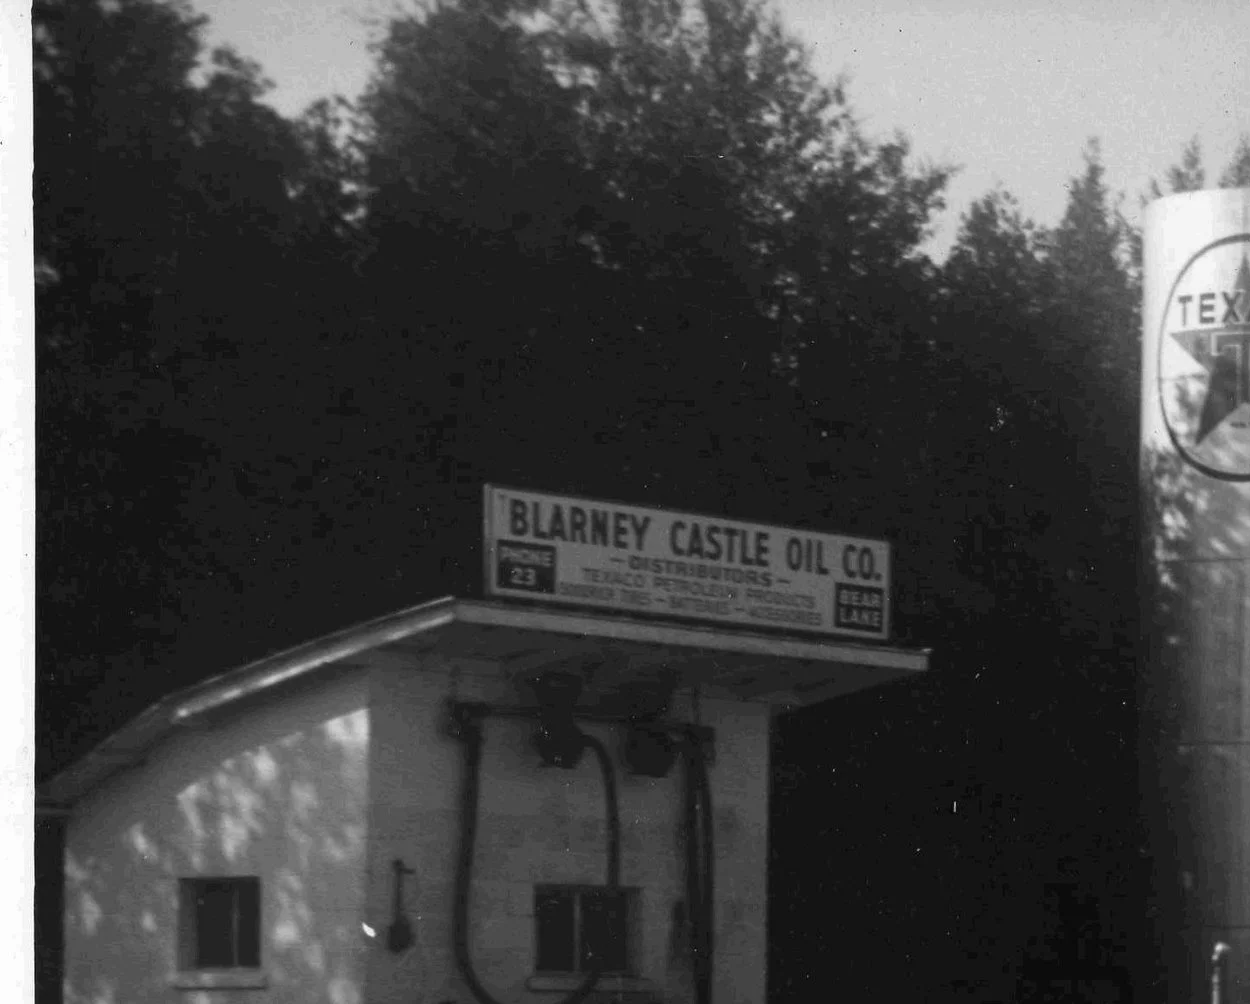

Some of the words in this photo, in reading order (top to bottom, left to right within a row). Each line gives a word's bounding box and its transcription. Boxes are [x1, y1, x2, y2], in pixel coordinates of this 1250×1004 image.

[509, 498, 651, 551] BLARNEY
[670, 520, 770, 567] CASTLE
[786, 537, 829, 575] OIL
[842, 543, 882, 581] CO.
[511, 567, 537, 586] 23
[582, 567, 650, 588] TEXACO
[628, 555, 772, 587] DISTRIBUTORS
[839, 588, 882, 607] BEAR
[839, 608, 882, 627] LAKE
